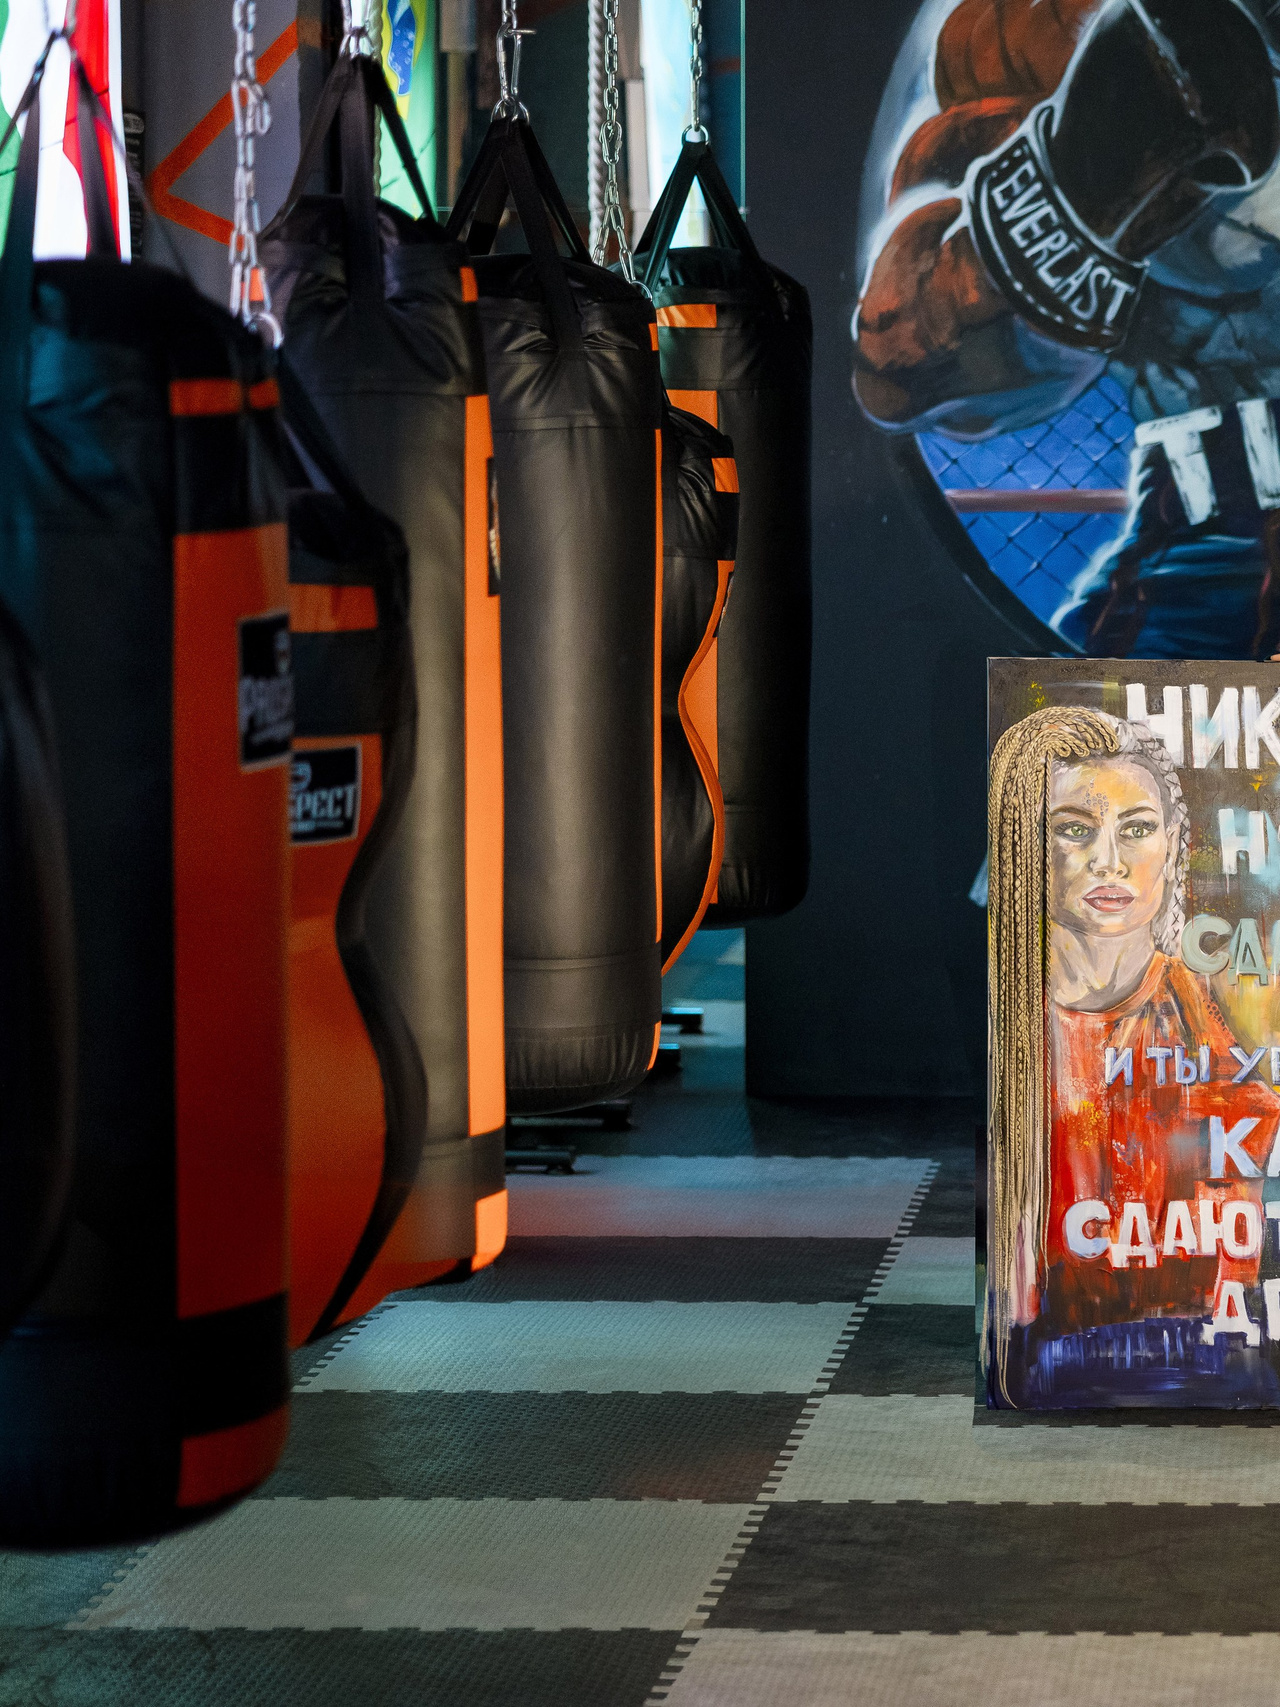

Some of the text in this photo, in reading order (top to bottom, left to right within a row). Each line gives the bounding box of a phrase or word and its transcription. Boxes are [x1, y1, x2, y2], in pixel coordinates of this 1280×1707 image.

[991, 160, 1136, 328] EVERLAST
[289, 784, 357, 824] PECT
[1104, 1046, 1134, 1087] И
[1146, 1045, 1211, 1084] ТЫ
